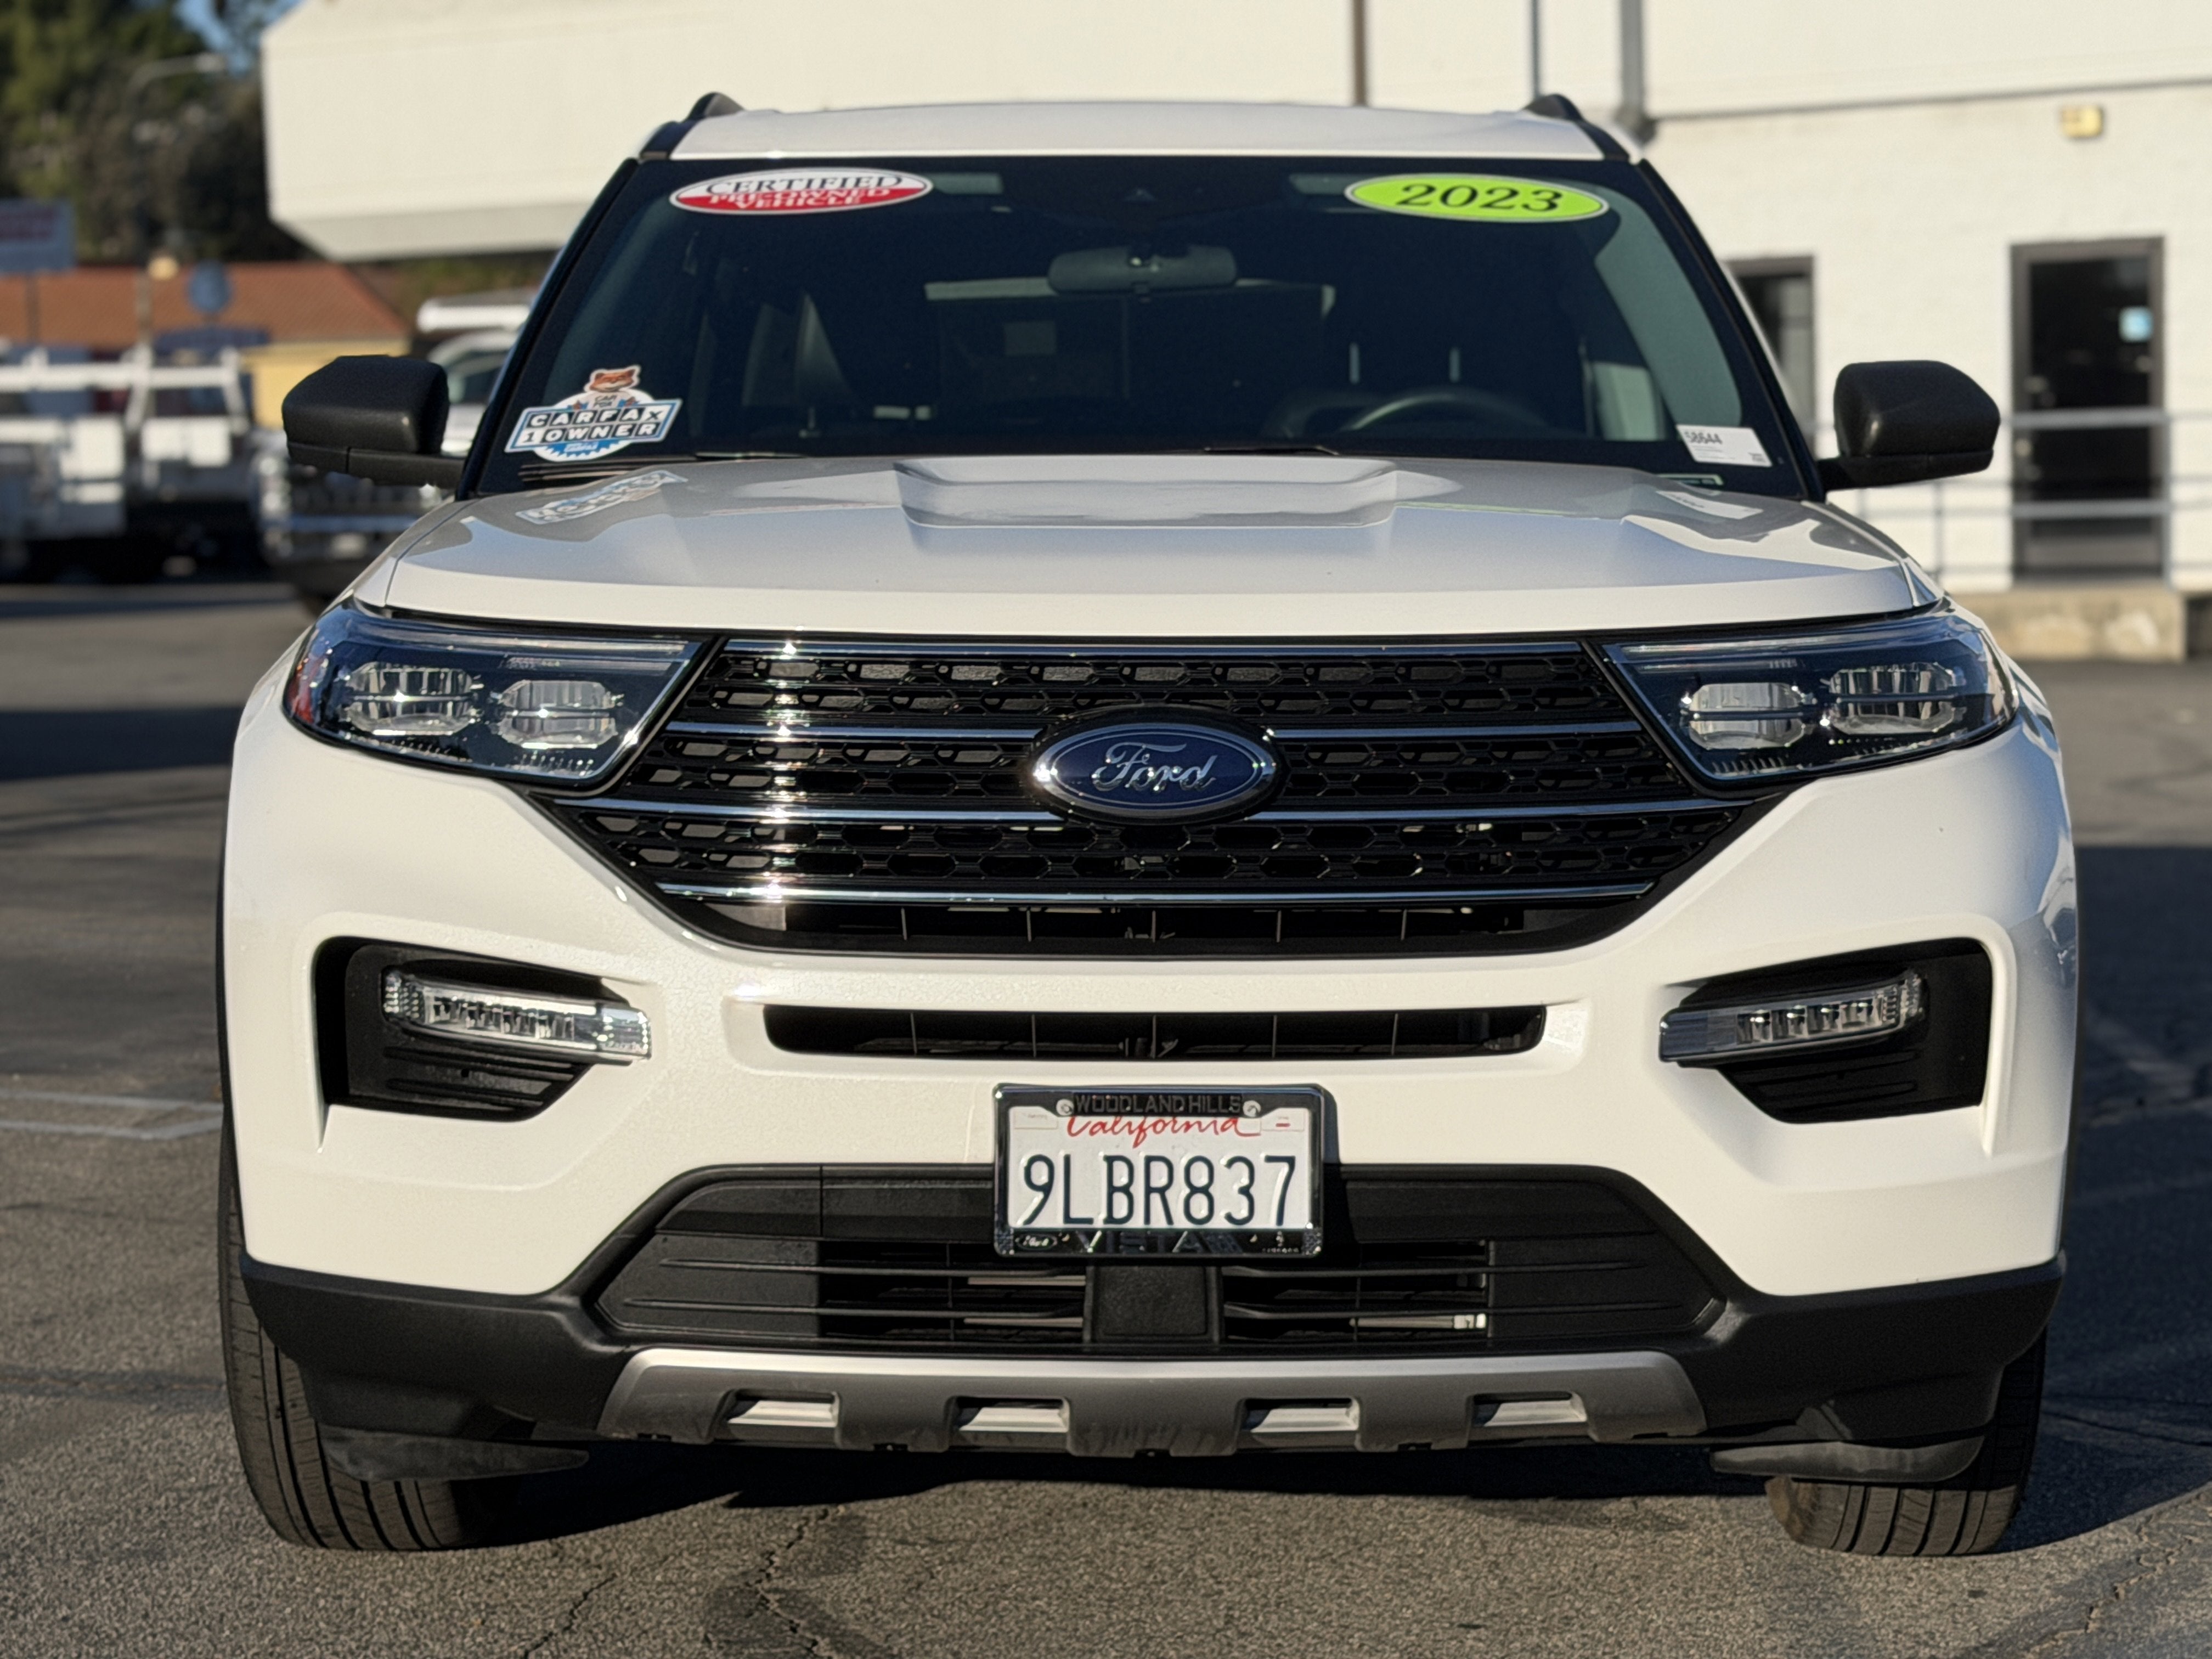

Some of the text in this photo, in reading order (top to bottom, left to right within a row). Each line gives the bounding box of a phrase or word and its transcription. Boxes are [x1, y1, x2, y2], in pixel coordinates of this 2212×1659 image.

[706, 176, 902, 195] CERTIFIED
[736, 195, 861, 208] VEHICLE
[1396, 183, 1563, 212] 2023
[529, 408, 663, 427] CARFAX
[522, 424, 656, 443] 1 OWNER
[1093, 741, 1217, 791] Ford
[1075, 1094, 1241, 1113] WOODLAND HILLS
[1066, 1115, 1262, 1149] California
[1022, 1154, 1296, 1226] 9LBR837
